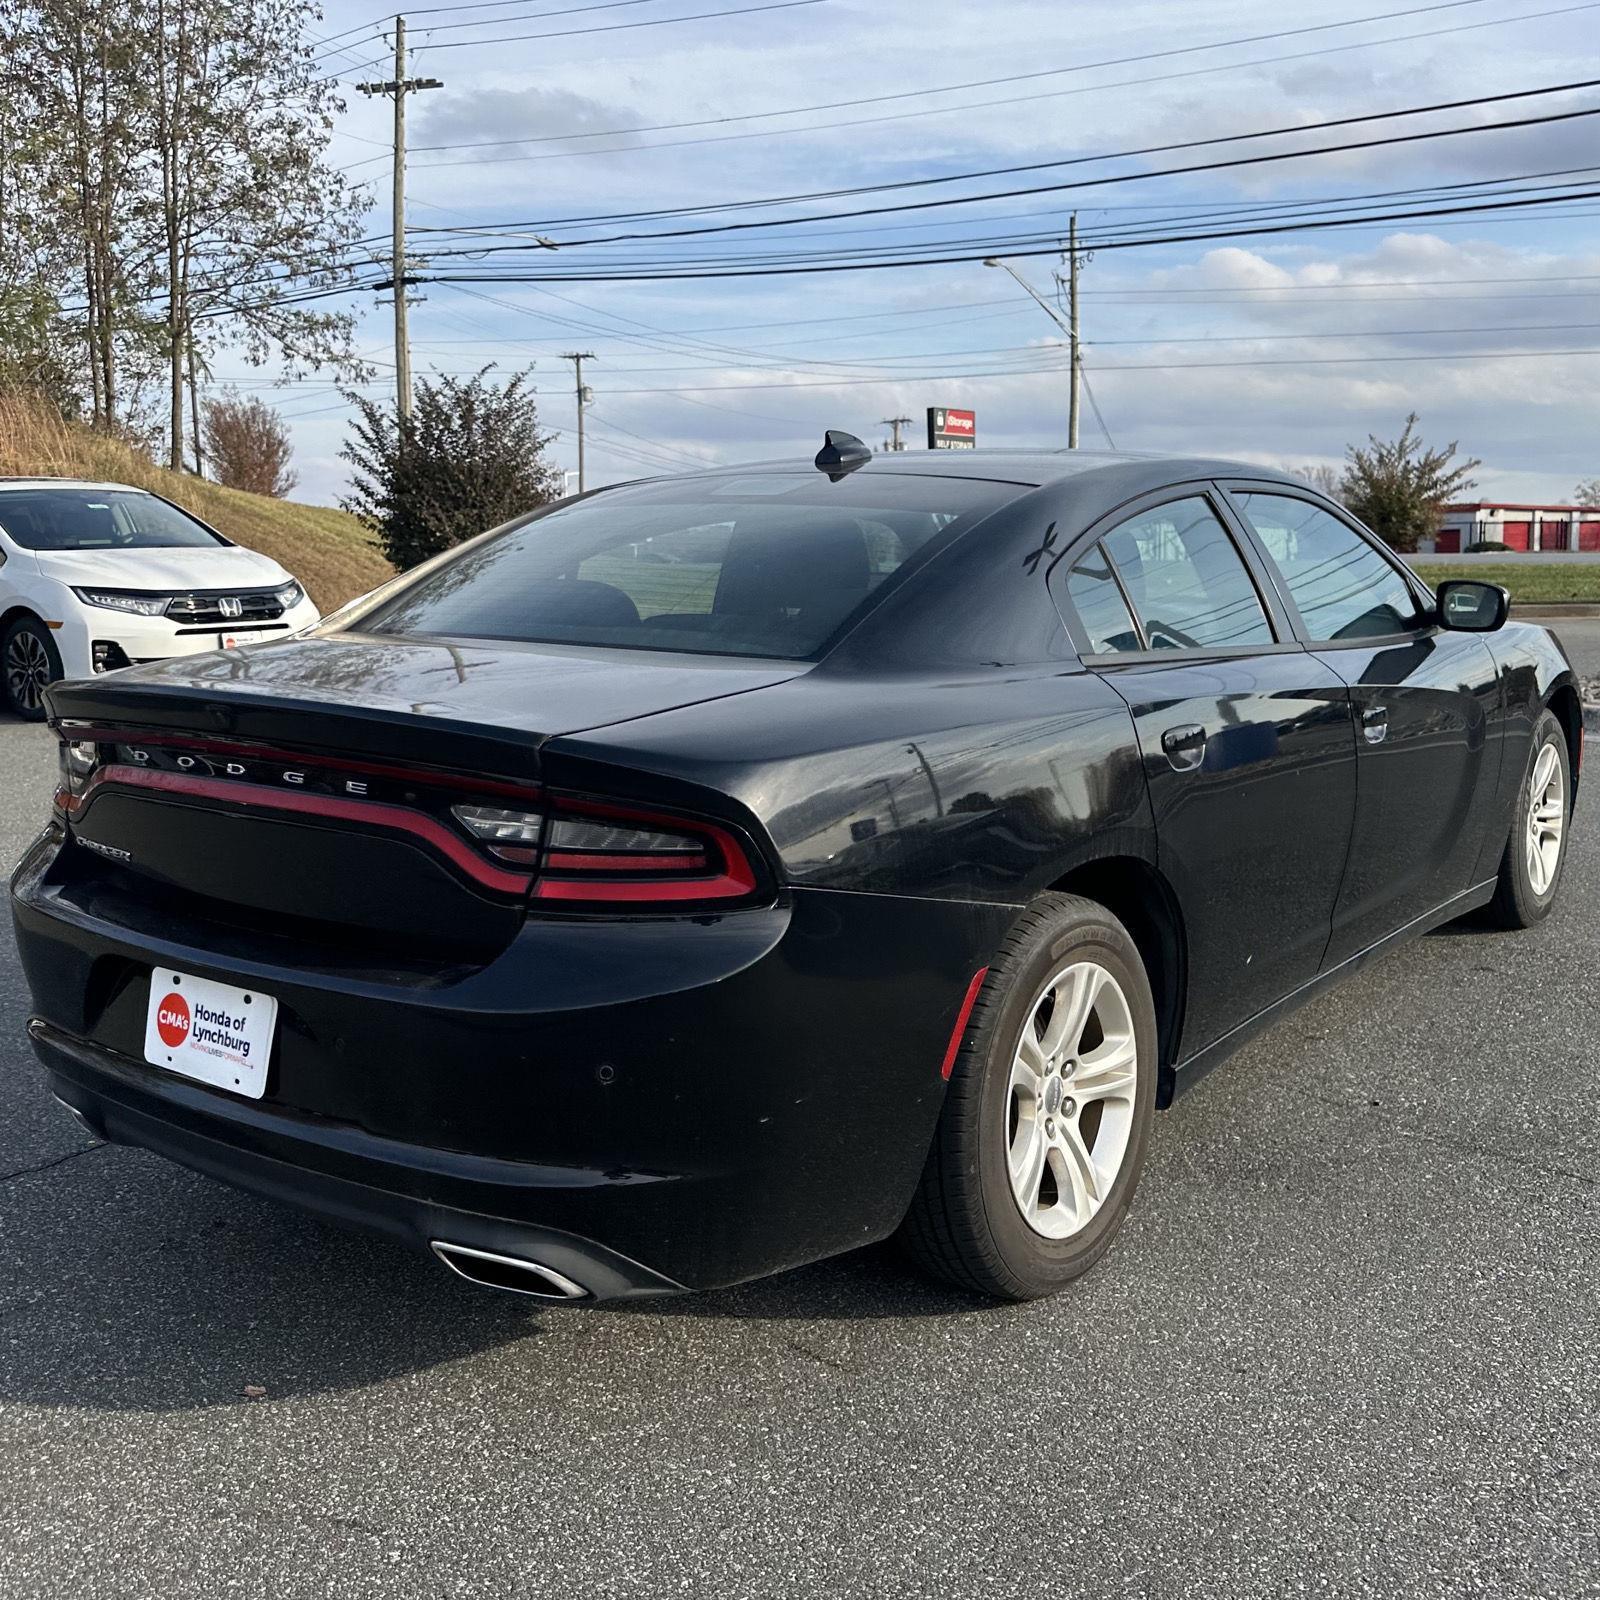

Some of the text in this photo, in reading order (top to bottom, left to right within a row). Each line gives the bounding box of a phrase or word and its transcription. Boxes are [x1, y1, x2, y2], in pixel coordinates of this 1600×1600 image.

[133, 750, 368, 795] DODGE
[159, 1009, 189, 1031] CMA's
[194, 1003, 247, 1032] Honda of
[192, 1021, 250, 1056] Lynchburg
